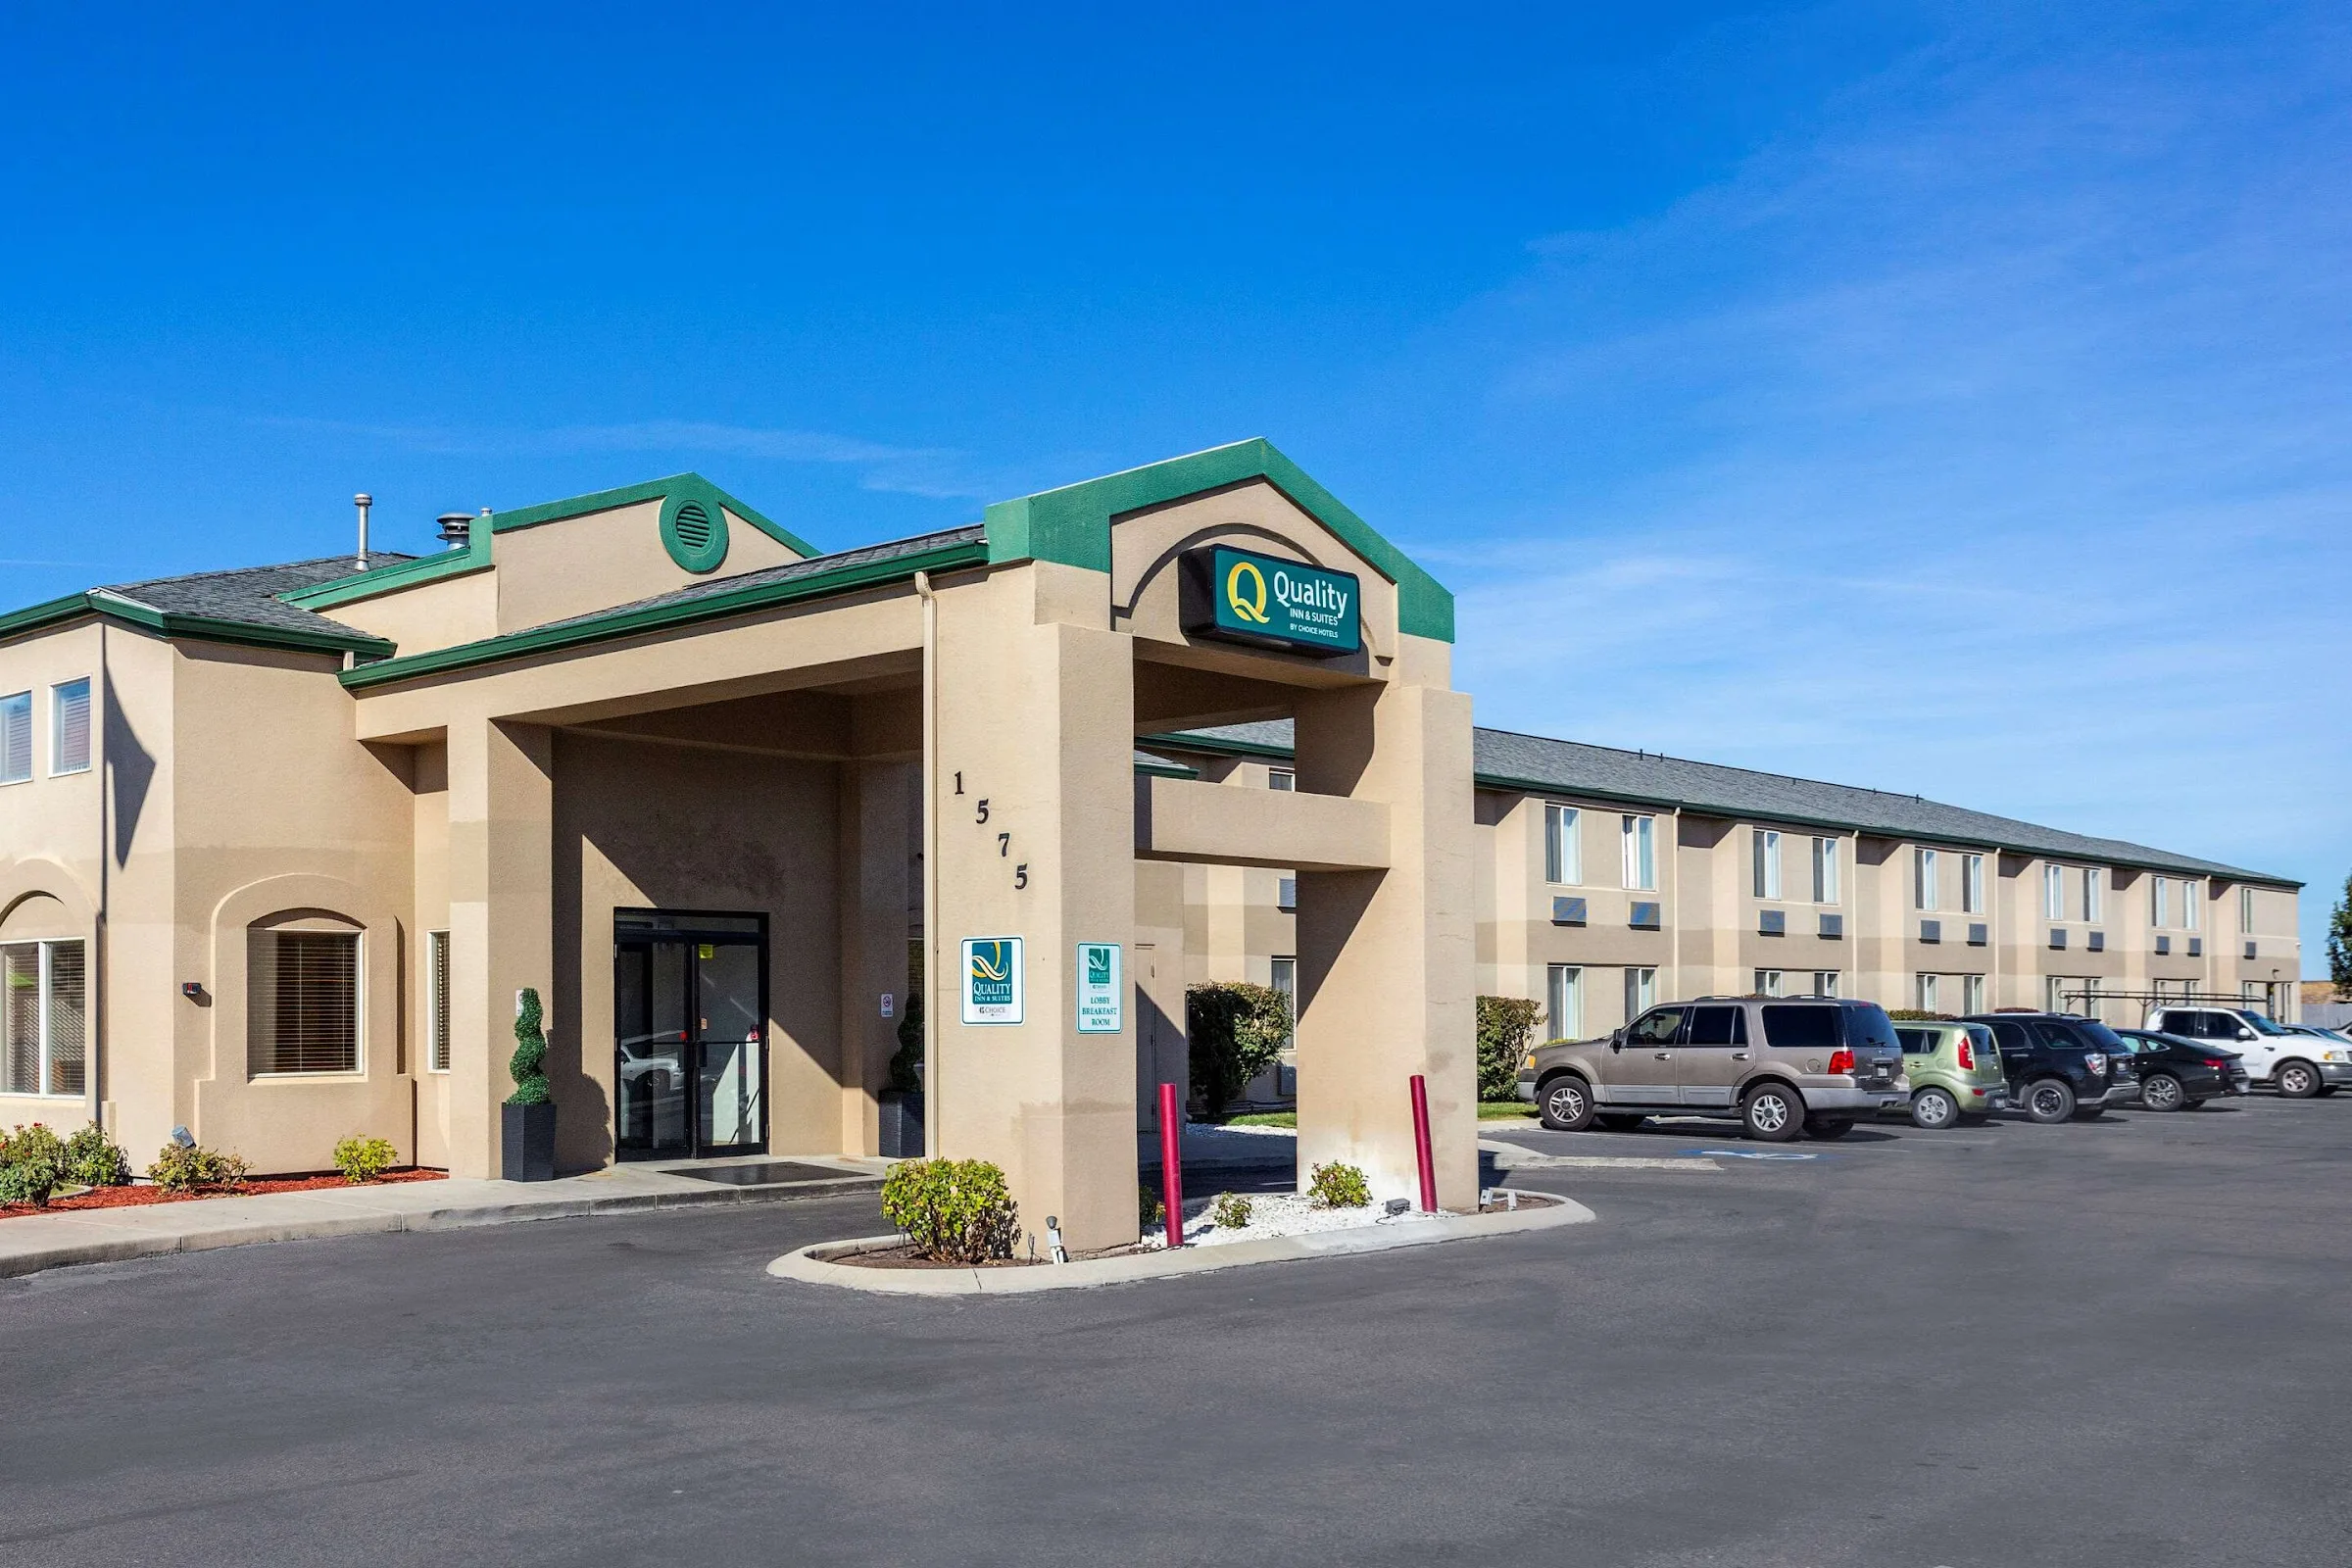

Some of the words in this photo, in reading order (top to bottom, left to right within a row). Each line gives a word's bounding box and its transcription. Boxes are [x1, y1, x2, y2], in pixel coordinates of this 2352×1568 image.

[1227, 562, 1270, 623] Q
[1274, 570, 1348, 619] Quality
[1290, 608, 1304, 619] INN
[1304, 610, 1311, 621] &
[1311, 612, 1339, 626] SUITES
[1290, 622, 1298, 631] BY
[1298, 624, 1318, 635] CHOICE
[1318, 628, 1339, 639] HOTELS
[973, 981, 1011, 996] QUALITY
